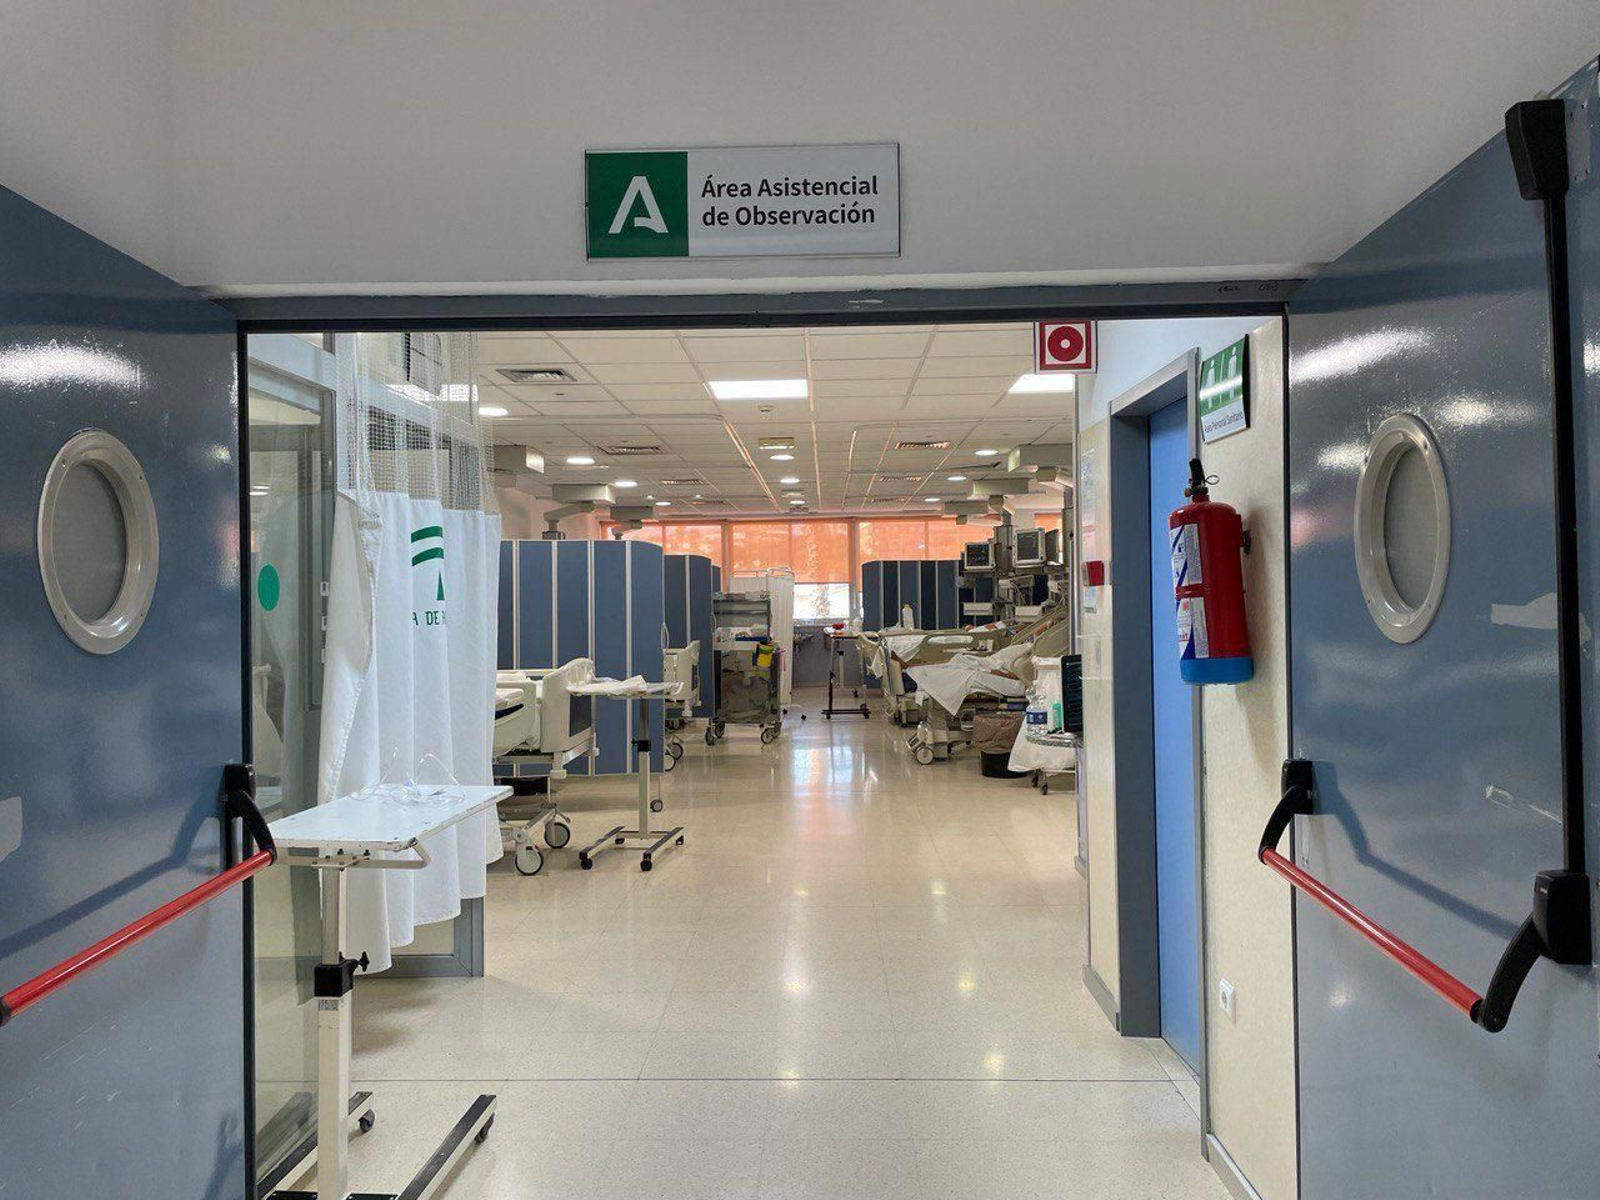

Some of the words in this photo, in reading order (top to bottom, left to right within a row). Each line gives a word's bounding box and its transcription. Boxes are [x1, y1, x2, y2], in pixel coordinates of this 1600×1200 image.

[700, 174, 752, 198] Área
[756, 174, 878, 197] Asistencial
[702, 205, 729, 226] de
[735, 201, 875, 226] Observación
[424, 610, 440, 626] DE
